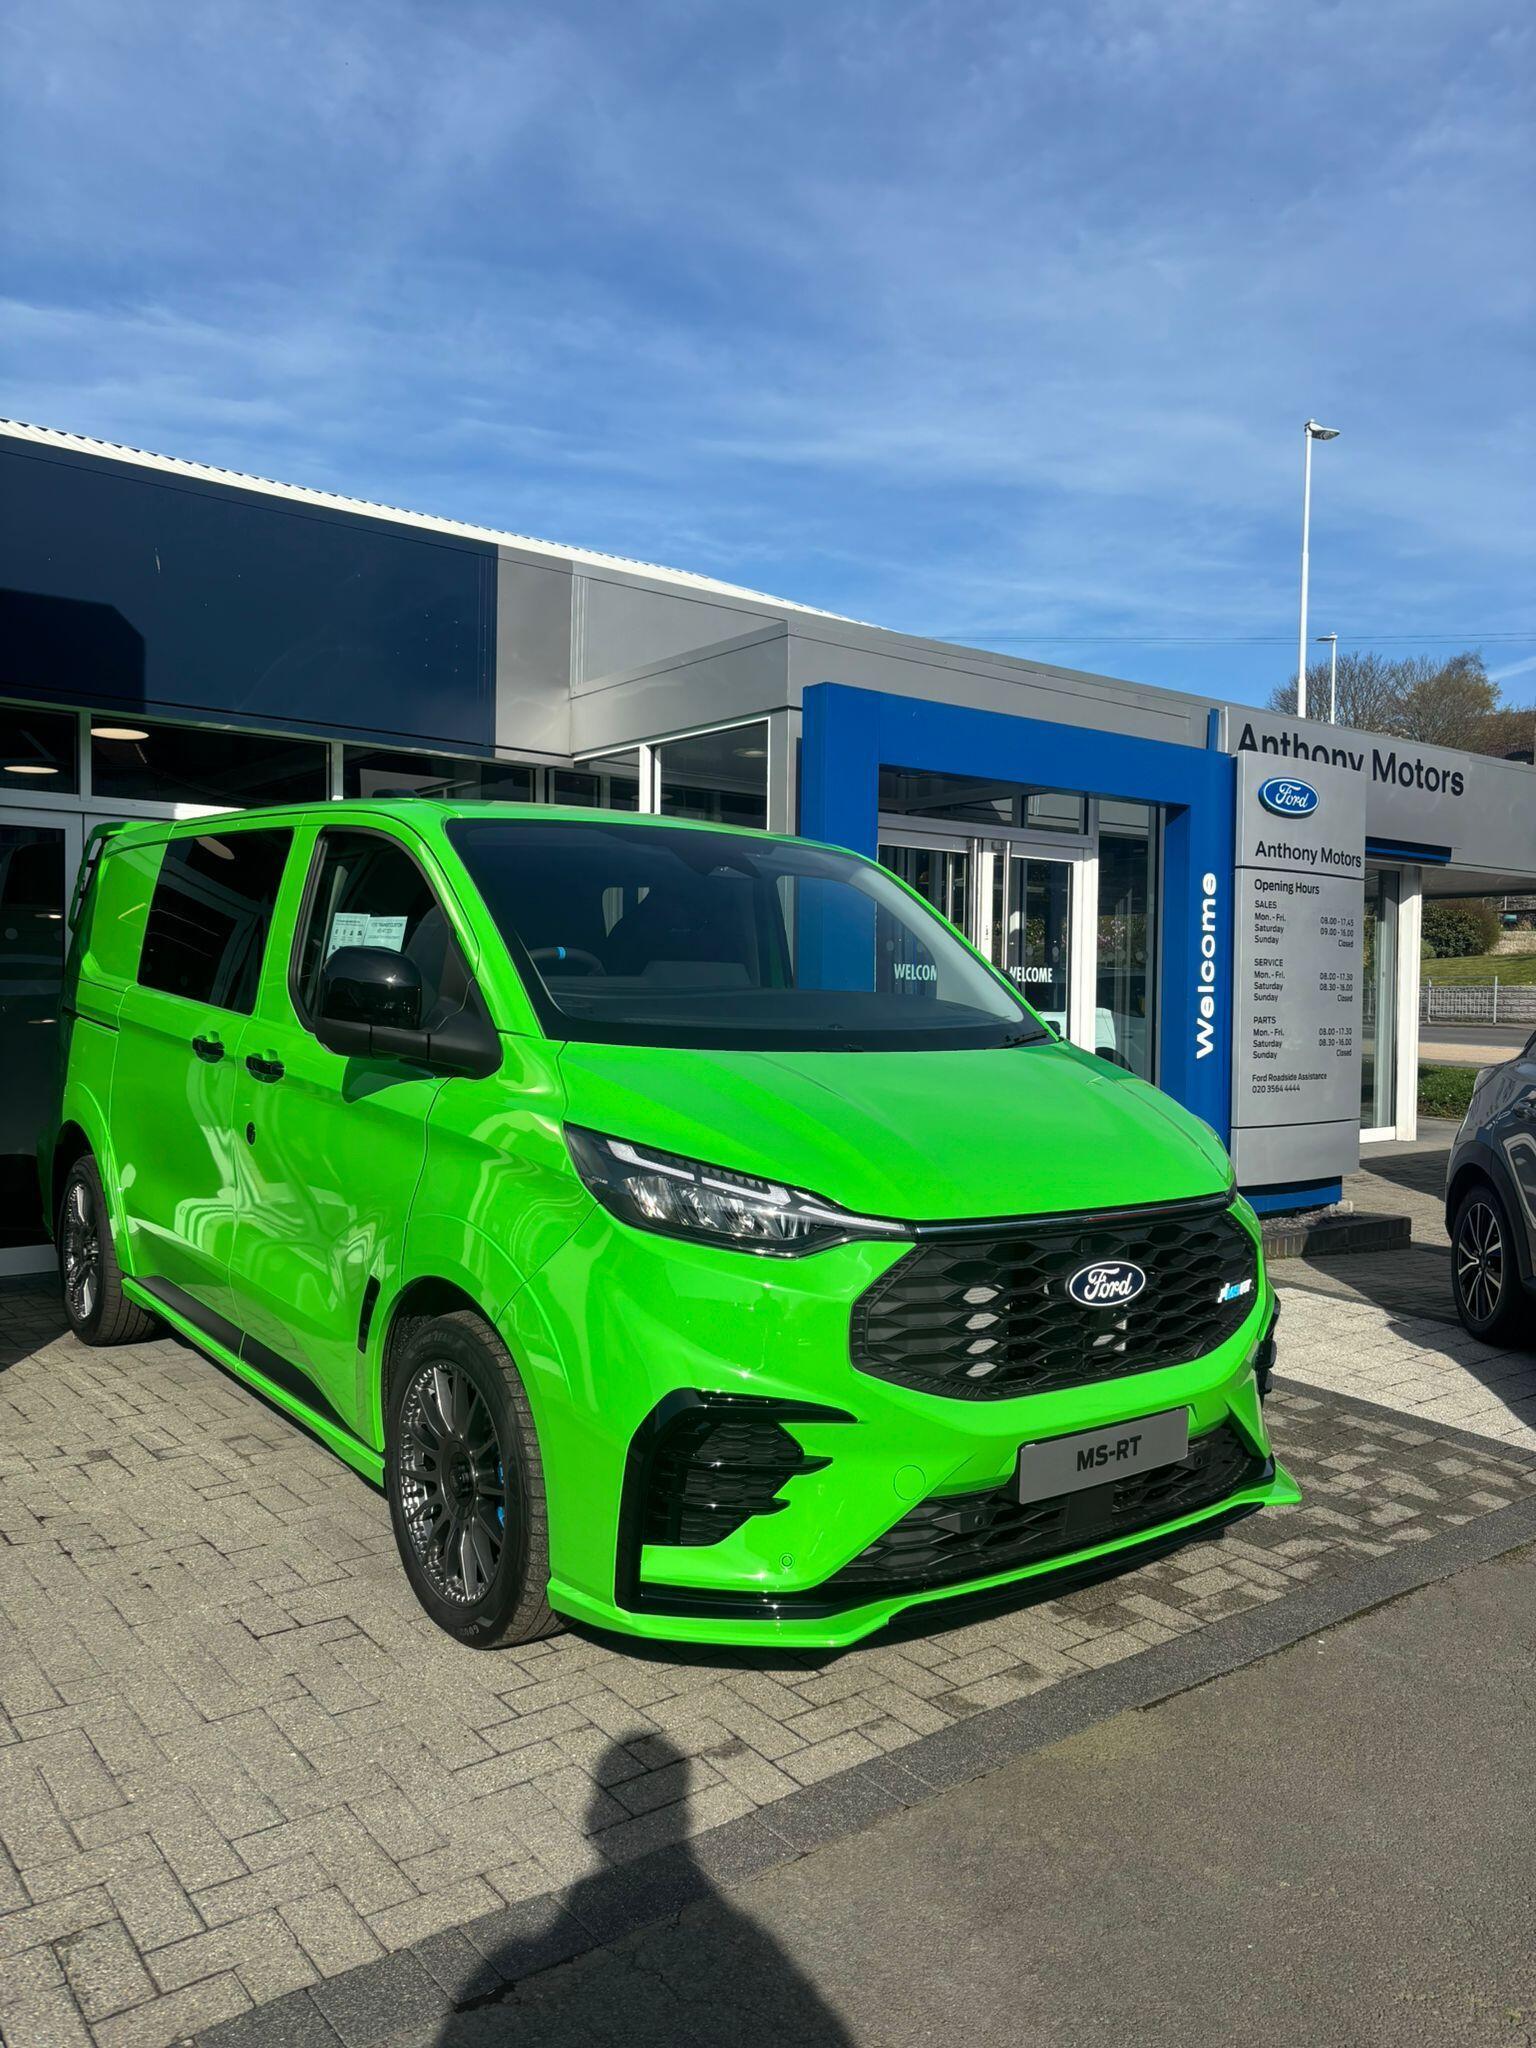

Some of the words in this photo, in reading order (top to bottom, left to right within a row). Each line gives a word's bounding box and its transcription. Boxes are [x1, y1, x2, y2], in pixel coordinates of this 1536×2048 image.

[1238, 723, 1364, 771] Anthony
[1372, 749, 1464, 796] Motors
[1275, 783, 1309, 808] Ford
[1255, 841, 1318, 865] Anthony
[1321, 847, 1362, 868] Motors
[1254, 879, 1294, 895] Opening
[1295, 882, 1320, 894] Hours
[1254, 900, 1277, 909] SALES
[1254, 913, 1272, 921] Mon.
[1276, 914, 1287, 922] Fri.
[1254, 924, 1284, 934] Saturday
[1254, 935, 1279, 945] Sunday
[1338, 939, 1354, 948] Closed
[1196, 872, 1217, 1059] Welcome
[1254, 959, 1283, 967] SERVICE
[1254, 971, 1271, 979] Mon.
[1254, 982, 1283, 992] Saturday
[1253, 993, 1279, 1003] Sunday
[1337, 994, 1353, 1002] Closed
[1253, 1016, 1277, 1024] PARTS
[1253, 1040, 1282, 1049] Saturday
[1253, 1051, 1278, 1060] Sunday
[1336, 1049, 1352, 1057] Closed
[1252, 1074, 1268, 1082] Ford
[1269, 1073, 1297, 1081] Roadside
[1298, 1073, 1327, 1081] Assistance
[1267, 1085, 1284, 1093] 3564
[1284, 1084, 1300, 1092] 4444
[1084, 1267, 1133, 1300] Ford
[1077, 1434, 1142, 1472] MS-RT
